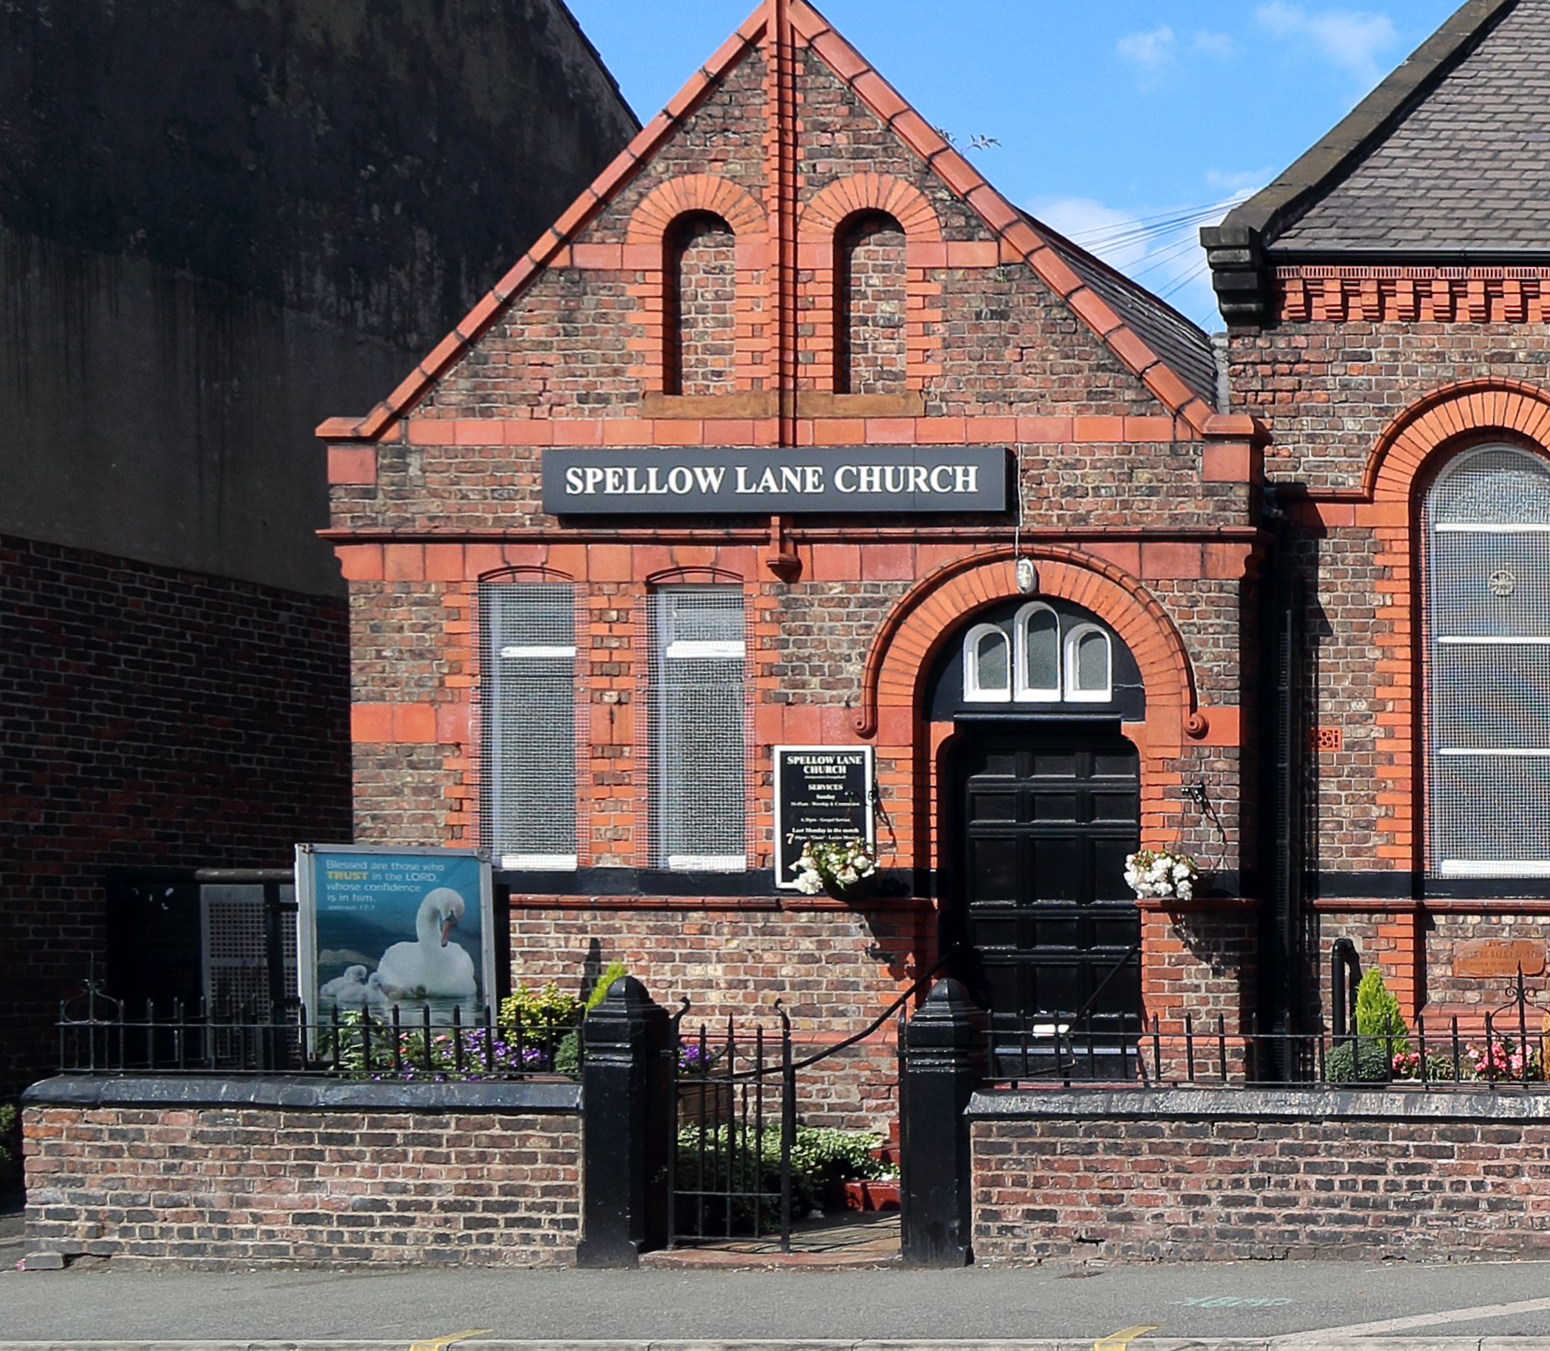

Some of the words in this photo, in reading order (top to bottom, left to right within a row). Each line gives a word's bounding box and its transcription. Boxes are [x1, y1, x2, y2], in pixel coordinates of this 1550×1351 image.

[566, 466, 726, 495] SPELLOW
[734, 466, 825, 494] LANE
[834, 465, 979, 493] CHURCH
[788, 756, 834, 764] SPELLOW
[836, 756, 862, 764] LANE
[786, 833, 794, 844] 7
[326, 860, 368, 870] Blessed
[391, 862, 420, 870] those
[423, 862, 444, 872] who
[326, 870, 368, 880] TRUST
[372, 872, 382, 880] in
[385, 872, 402, 880] the
[326, 882, 360, 890] whose
[364, 882, 420, 892] confidence
[327, 894, 336, 902] is
[339, 894, 348, 902] in
[352, 894, 376, 902] him.
